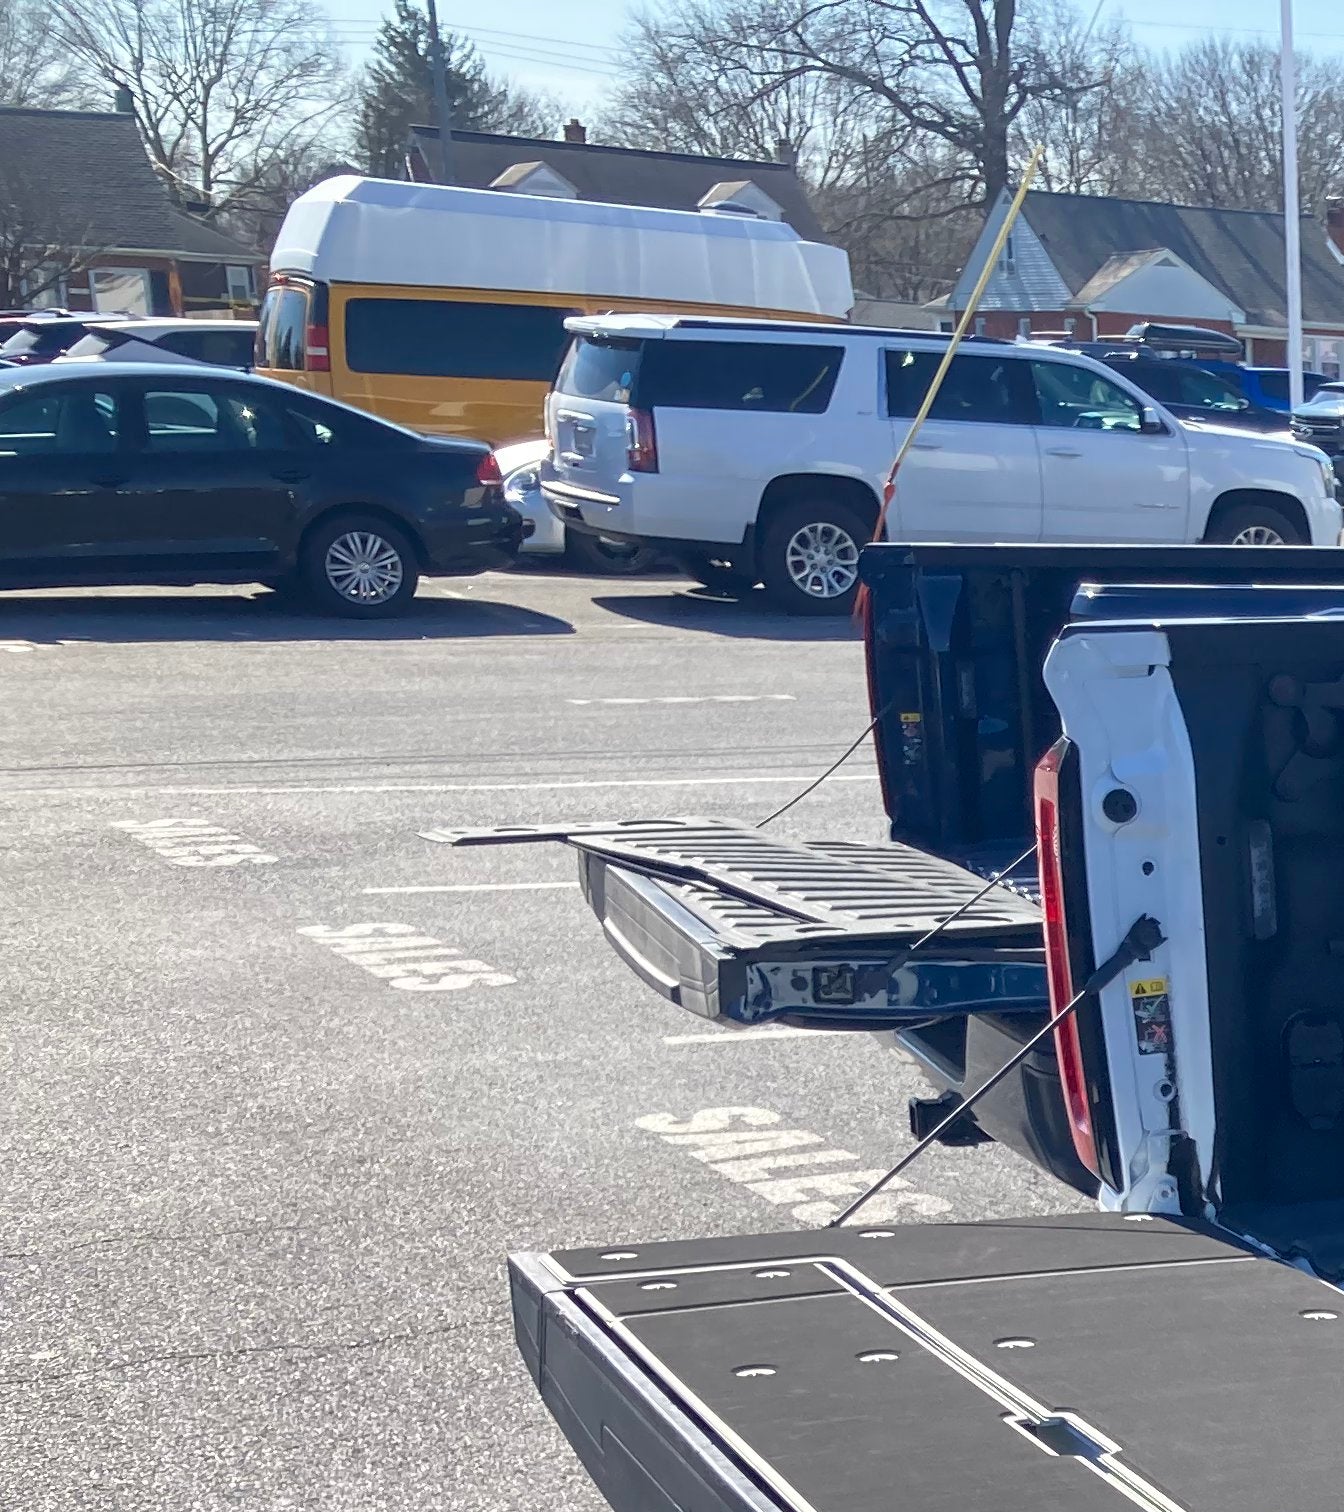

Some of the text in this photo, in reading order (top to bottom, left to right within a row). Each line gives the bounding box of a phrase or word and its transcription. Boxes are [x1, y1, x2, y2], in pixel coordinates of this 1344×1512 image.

[110, 818, 280, 867] SALES
[297, 922, 518, 991] SALES
[634, 1105, 953, 1229] SALES
